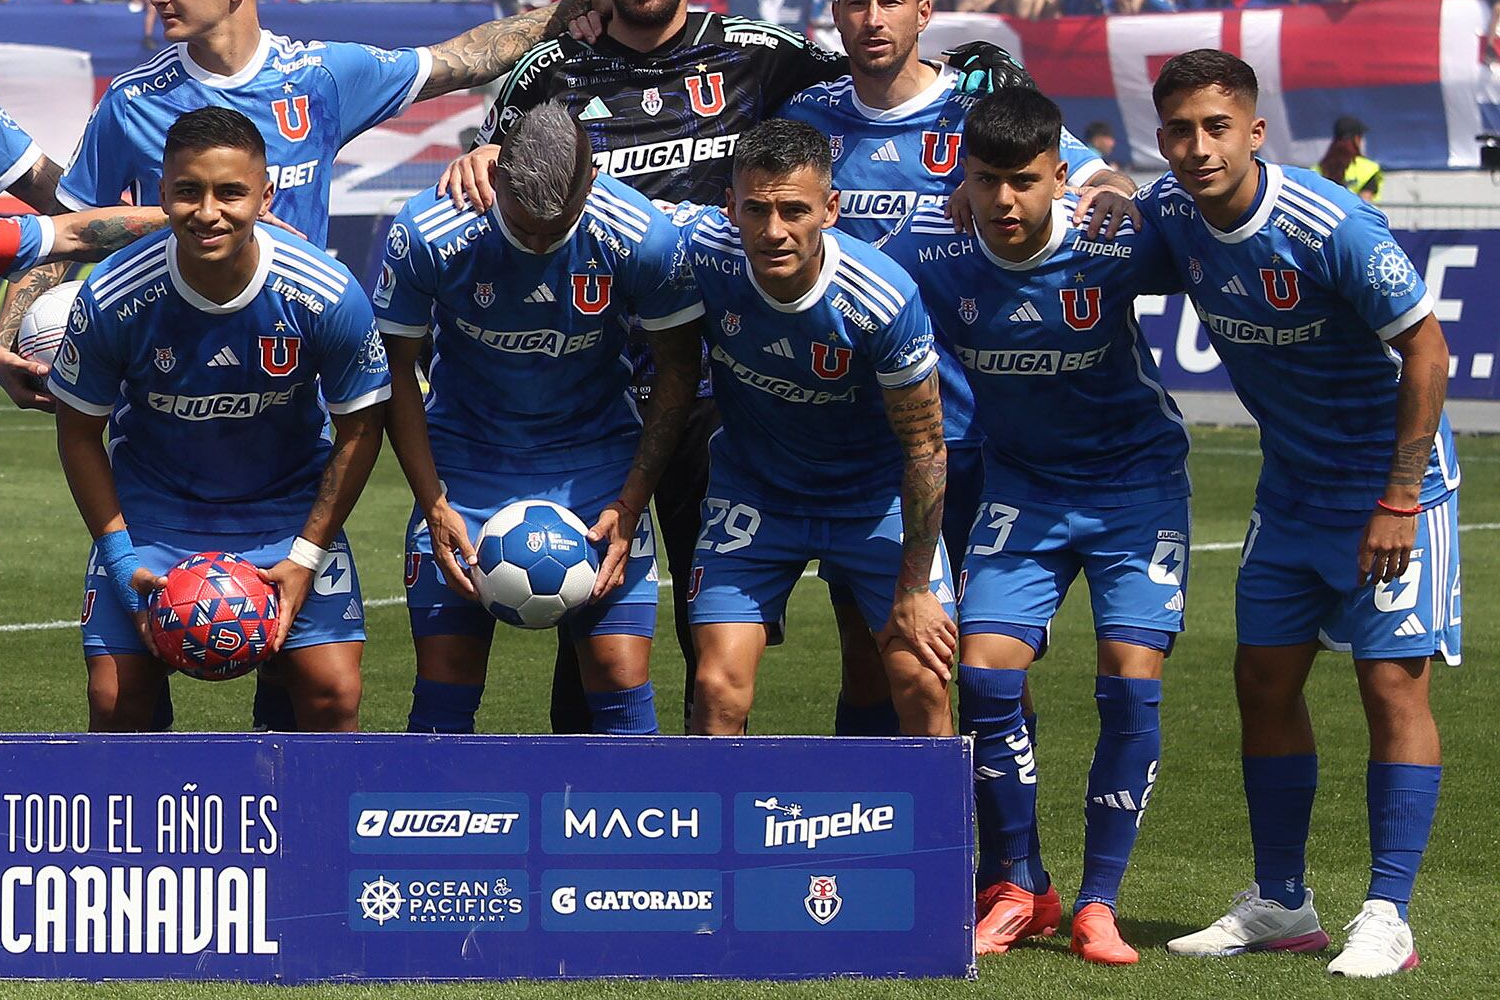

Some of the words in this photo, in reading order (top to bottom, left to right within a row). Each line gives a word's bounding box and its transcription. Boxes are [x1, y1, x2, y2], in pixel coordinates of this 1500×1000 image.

[124, 66, 180, 100] MACH
[517, 47, 565, 91] MACH
[684, 71, 726, 118] U
[271, 94, 312, 142] U
[609, 133, 741, 178] JUGABET
[921, 131, 964, 174] U
[437, 216, 493, 261] MACH
[919, 240, 975, 262] MACH
[1071, 236, 1133, 258] Impeke
[1273, 213, 1324, 252] Impeke
[694, 251, 741, 276] MACH
[116, 280, 168, 322] MACH
[271, 275, 325, 316] Impeke
[569, 273, 613, 315] U
[1060, 286, 1102, 332] U
[1260, 268, 1300, 311] U
[1210, 316, 1328, 346] JUGABET
[257, 336, 301, 378] U
[811, 341, 852, 381] U
[977, 342, 1111, 376] JUGABET
[697, 497, 762, 555] 29
[214, 628, 242, 652] U
[3, 793, 91, 854] TODO
[108, 794, 143, 854] EL
[157, 782, 224, 855] AÑO
[240, 794, 280, 856] ES
[390, 810, 520, 837] JUGABET
[563, 807, 700, 839] MACH
[763, 801, 895, 849] Impeke
[0, 864, 281, 955] CARNAVAL
[408, 881, 489, 897] OCEAN
[409, 898, 523, 914] PACIFIC'S
[551, 886, 577, 915] G
[584, 891, 714, 911] GATORADE
